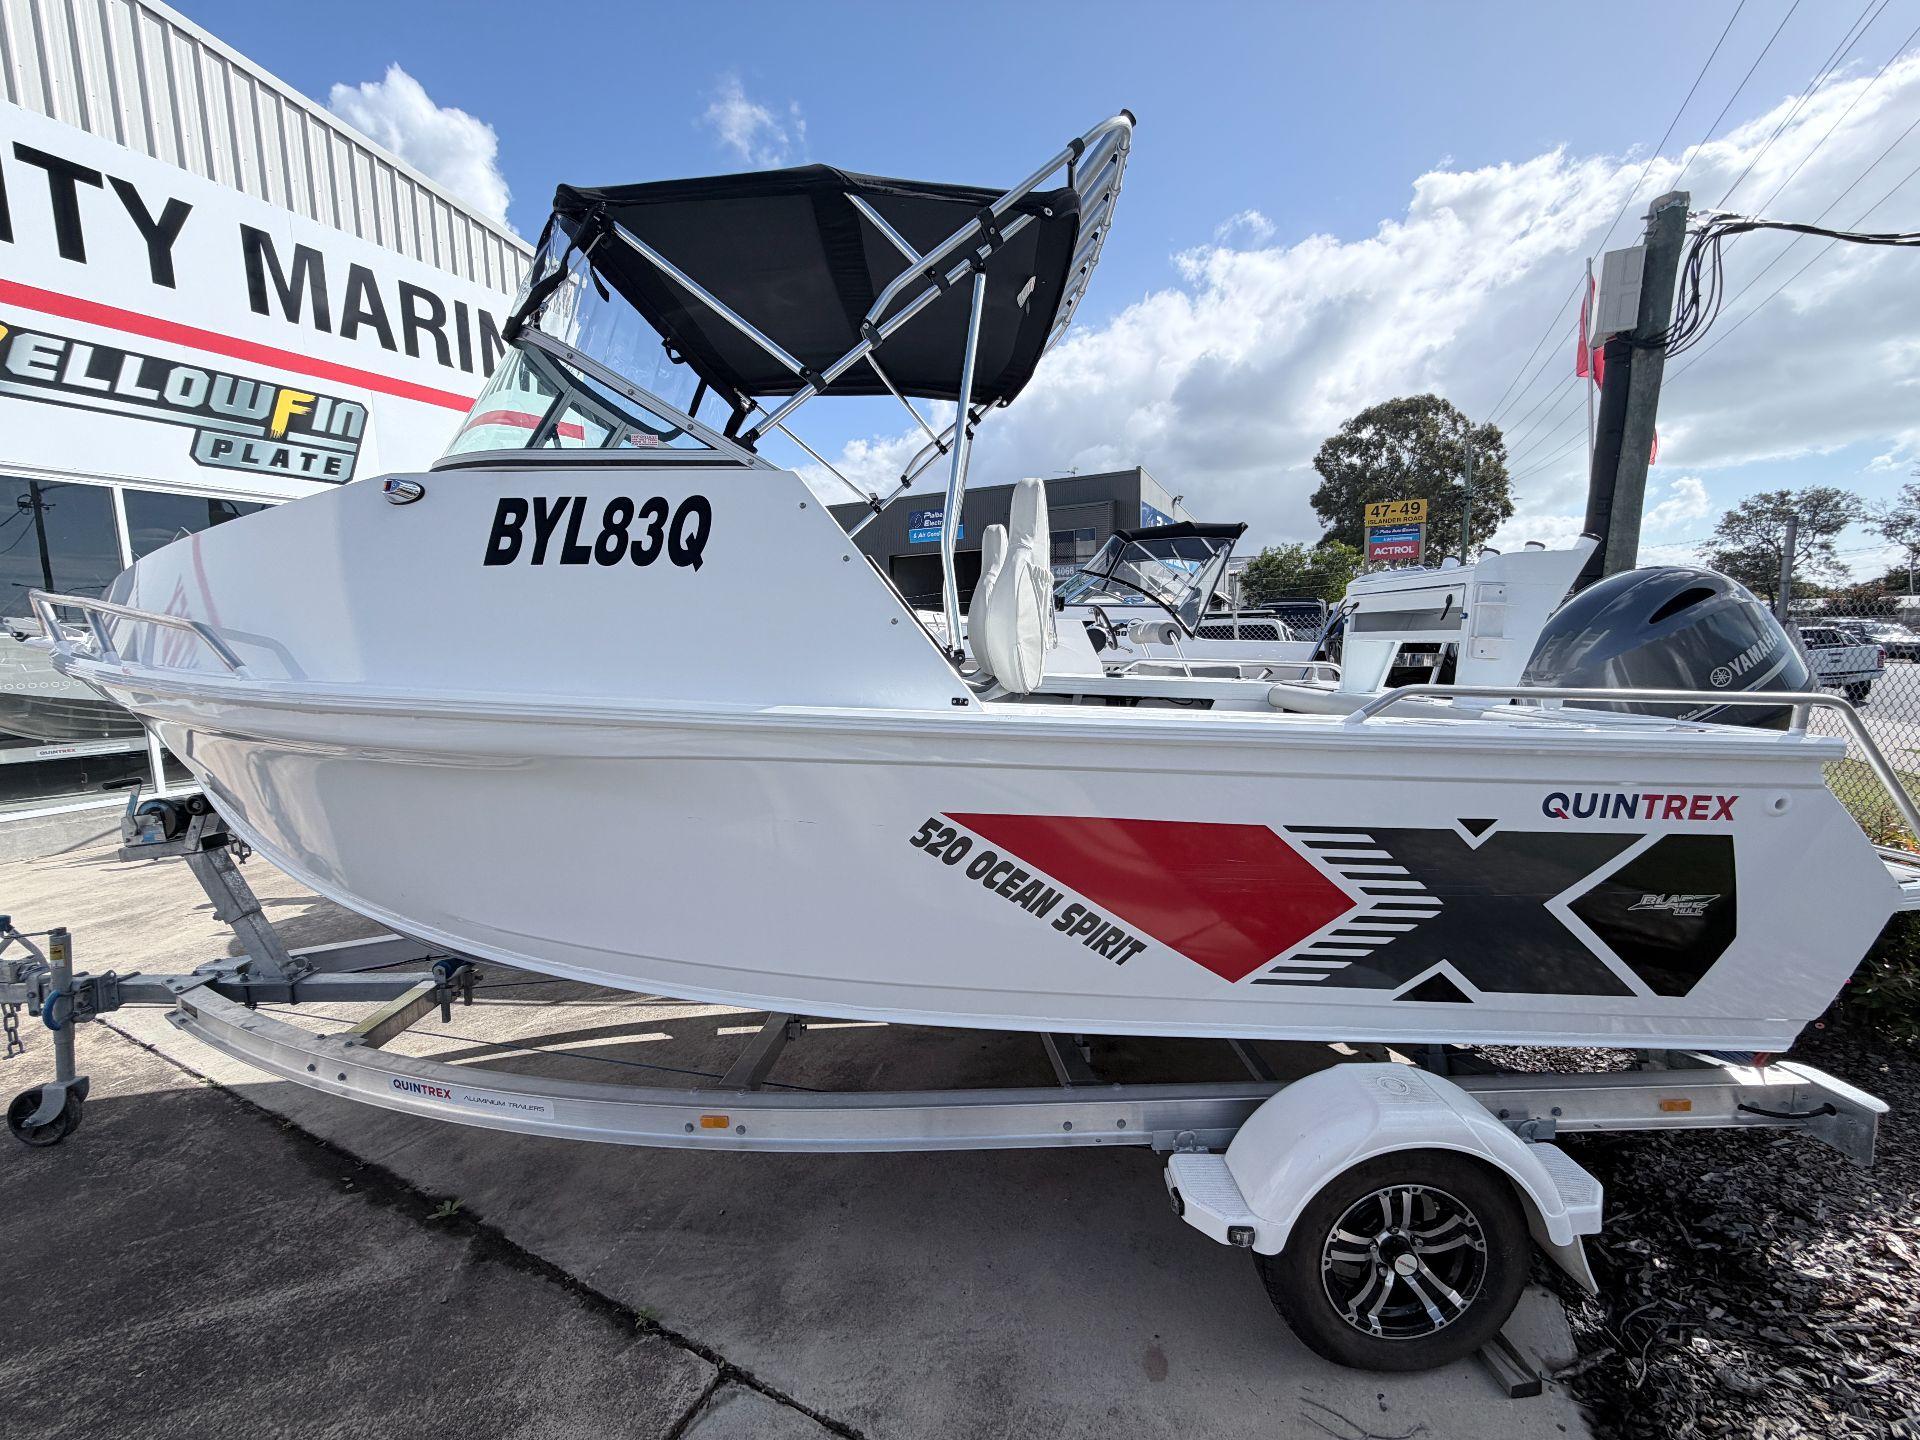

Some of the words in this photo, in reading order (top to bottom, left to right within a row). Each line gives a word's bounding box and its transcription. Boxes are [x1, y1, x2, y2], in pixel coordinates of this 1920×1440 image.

[0, 324, 366, 438] ELLOWFIN
[209, 438, 342, 476] PLATE
[483, 494, 713, 573] BYL83Q
[1374, 546, 1414, 555] ACTROL
[1727, 627, 1779, 677] YAMAHA
[1541, 791, 1740, 821] QUINTREX
[908, 816, 974, 866] 520
[965, 850, 1065, 919] OCEAN
[1050, 902, 1148, 966] SPIRIT
[1636, 893, 1714, 910] BLADE
[1673, 907, 1704, 916] HULL
[392, 1078, 452, 1100] QUINTREX
[507, 1101, 545, 1113] TRAILERS
